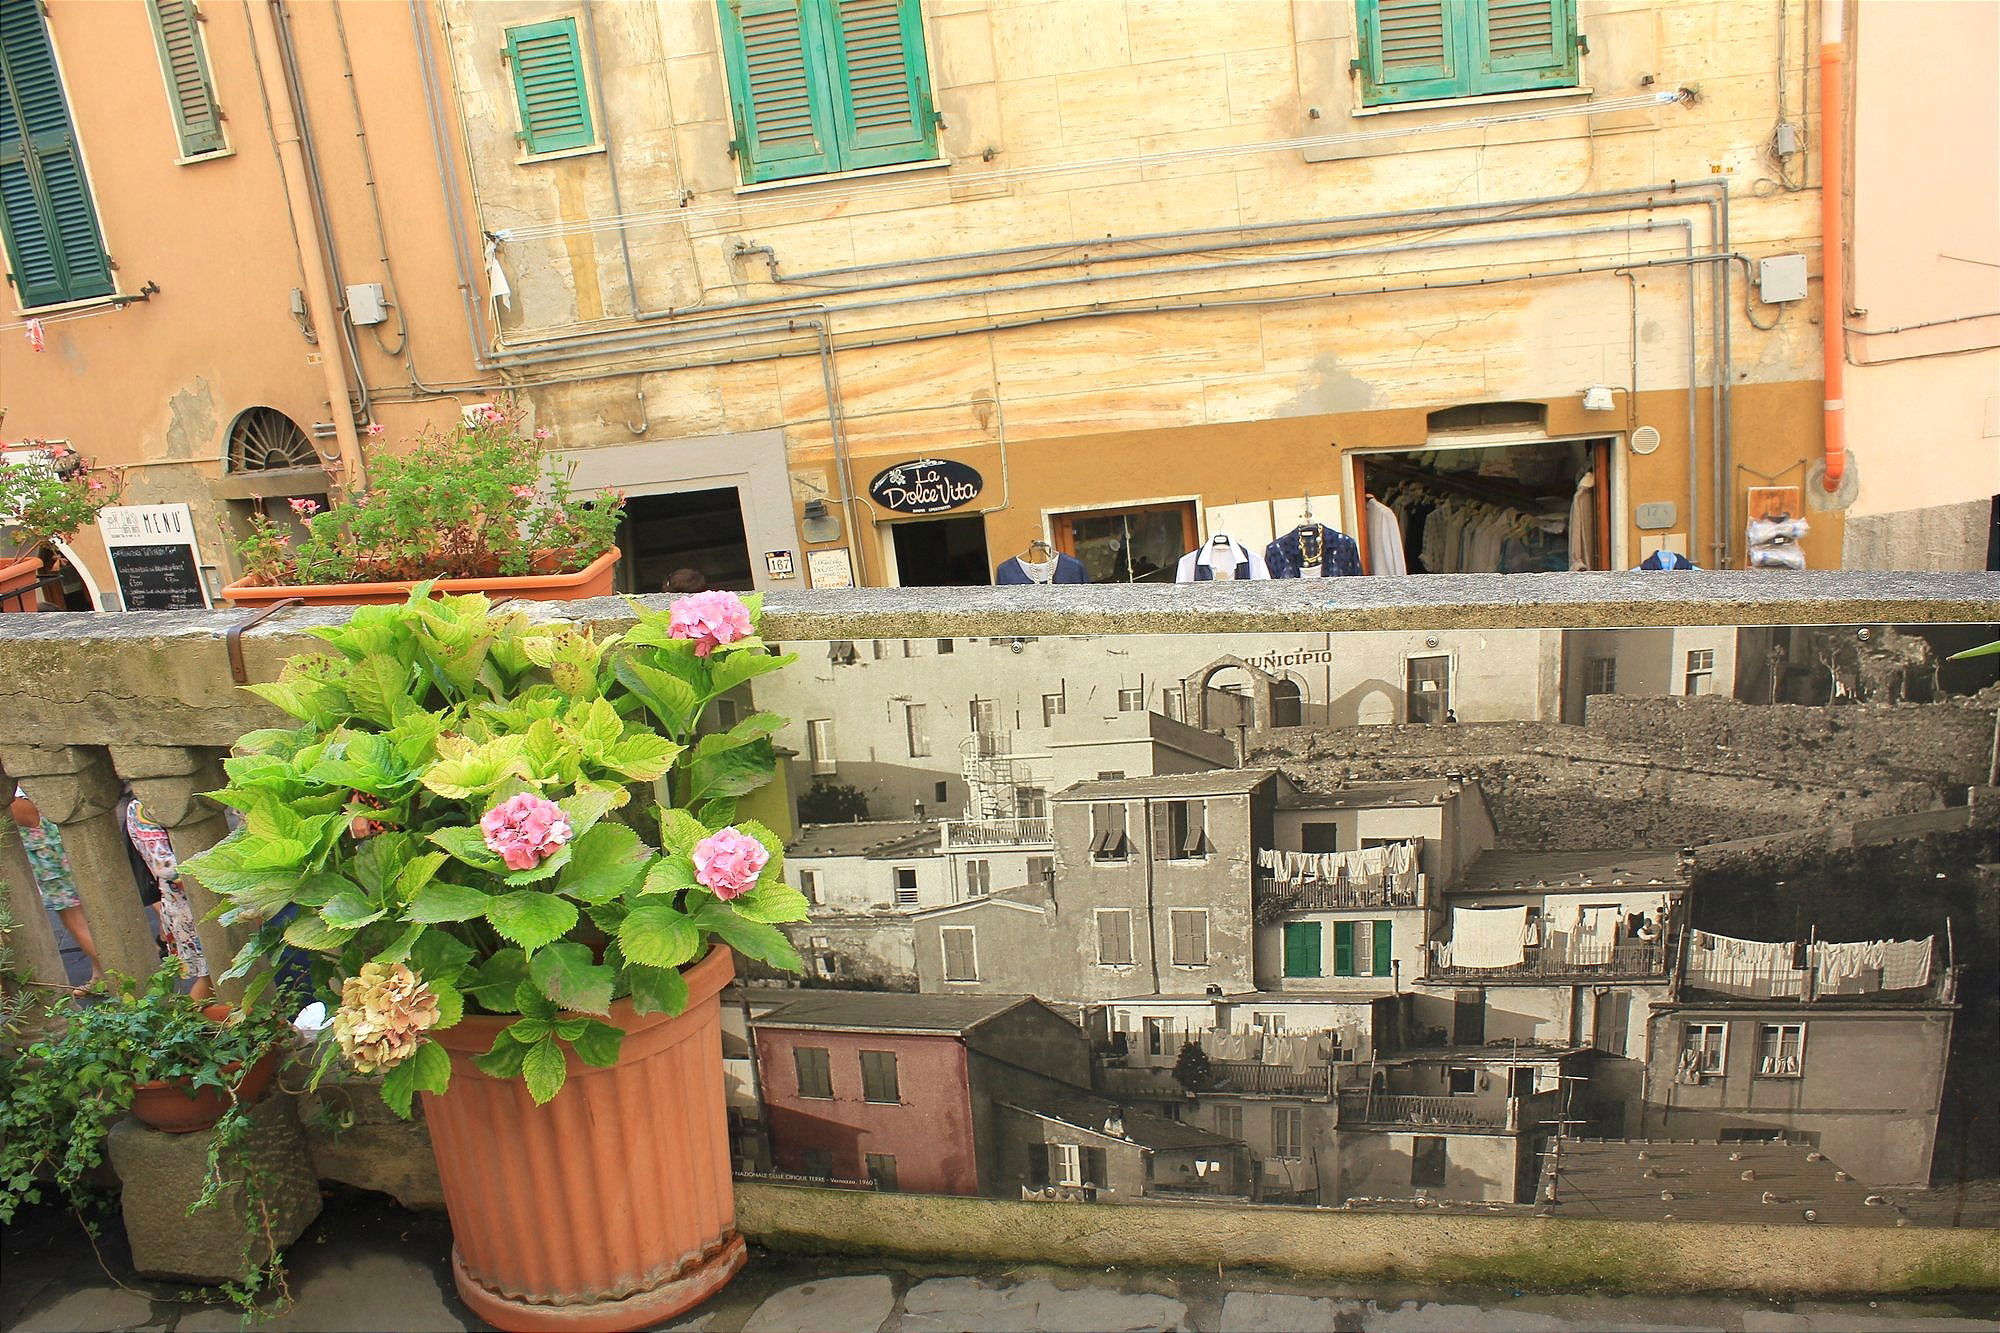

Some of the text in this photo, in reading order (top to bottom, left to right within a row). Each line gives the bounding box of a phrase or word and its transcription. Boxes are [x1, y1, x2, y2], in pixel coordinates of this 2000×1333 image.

[915, 468, 940, 484] La
[882, 477, 978, 508] Dolce Vita
[771, 559, 790, 571] 167
[1245, 652, 1332, 668] UNICIPIO
